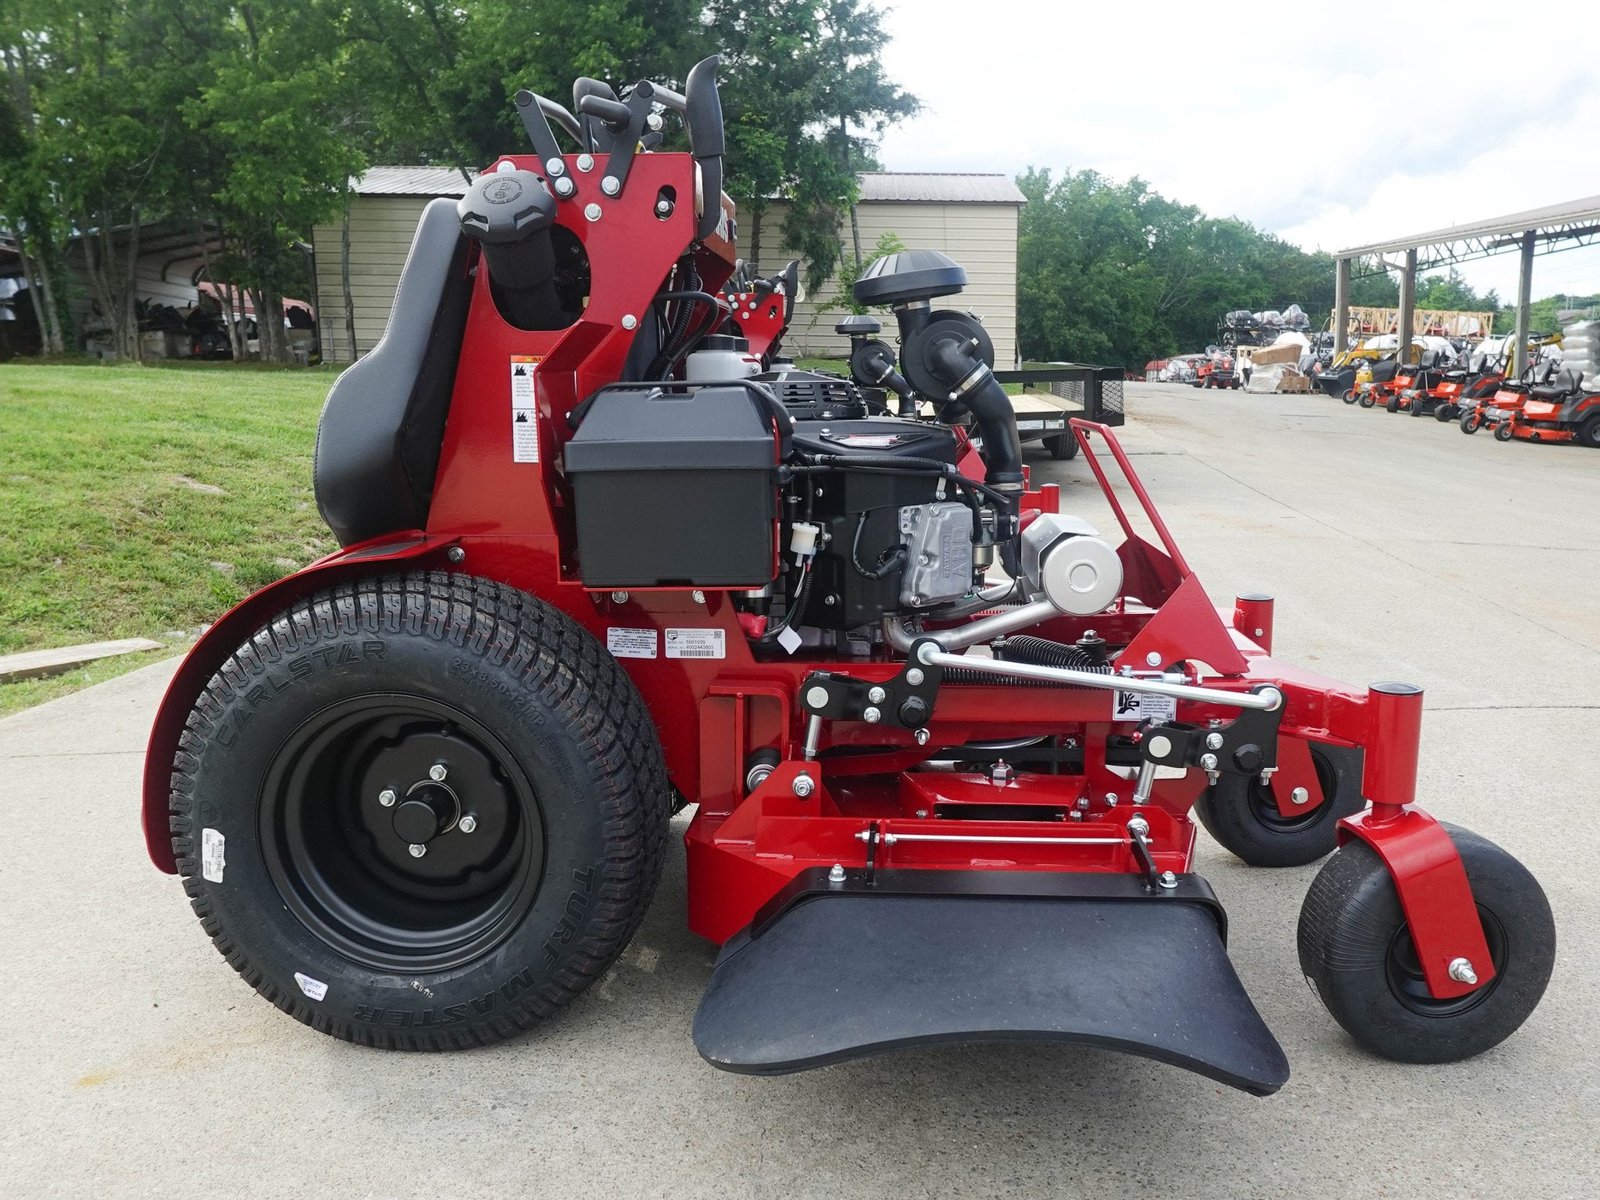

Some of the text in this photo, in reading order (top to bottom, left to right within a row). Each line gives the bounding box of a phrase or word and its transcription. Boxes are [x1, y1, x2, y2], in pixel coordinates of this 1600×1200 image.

[214, 640, 387, 749] CARLSTAR
[543, 866, 596, 969] TURF
[353, 966, 537, 1028] MASTER
